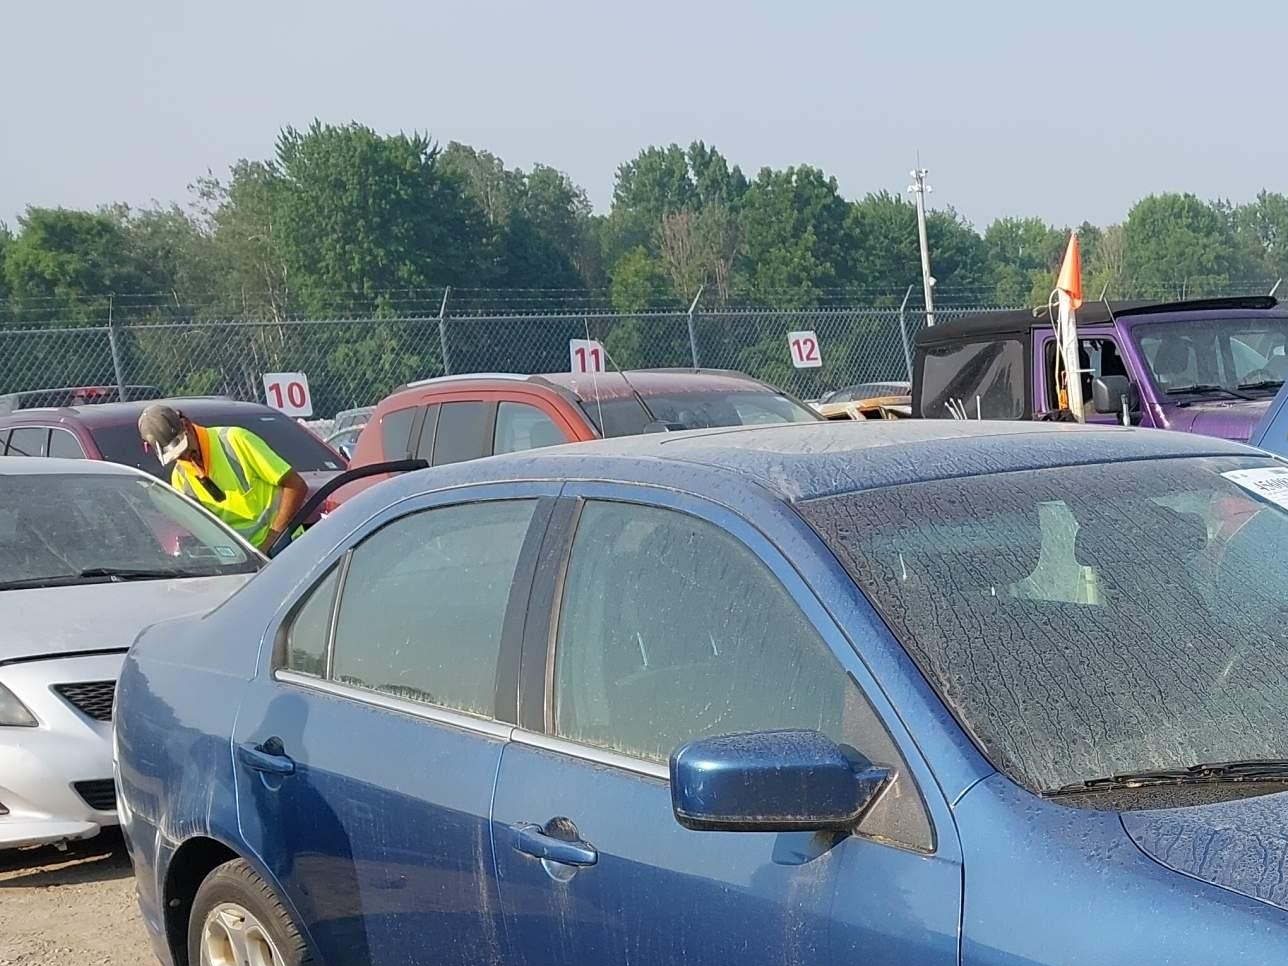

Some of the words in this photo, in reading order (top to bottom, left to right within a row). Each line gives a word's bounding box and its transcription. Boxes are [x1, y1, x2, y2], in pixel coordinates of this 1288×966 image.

[575, 347, 601, 373] 11
[792, 338, 819, 362] 12
[268, 382, 306, 409] 10
